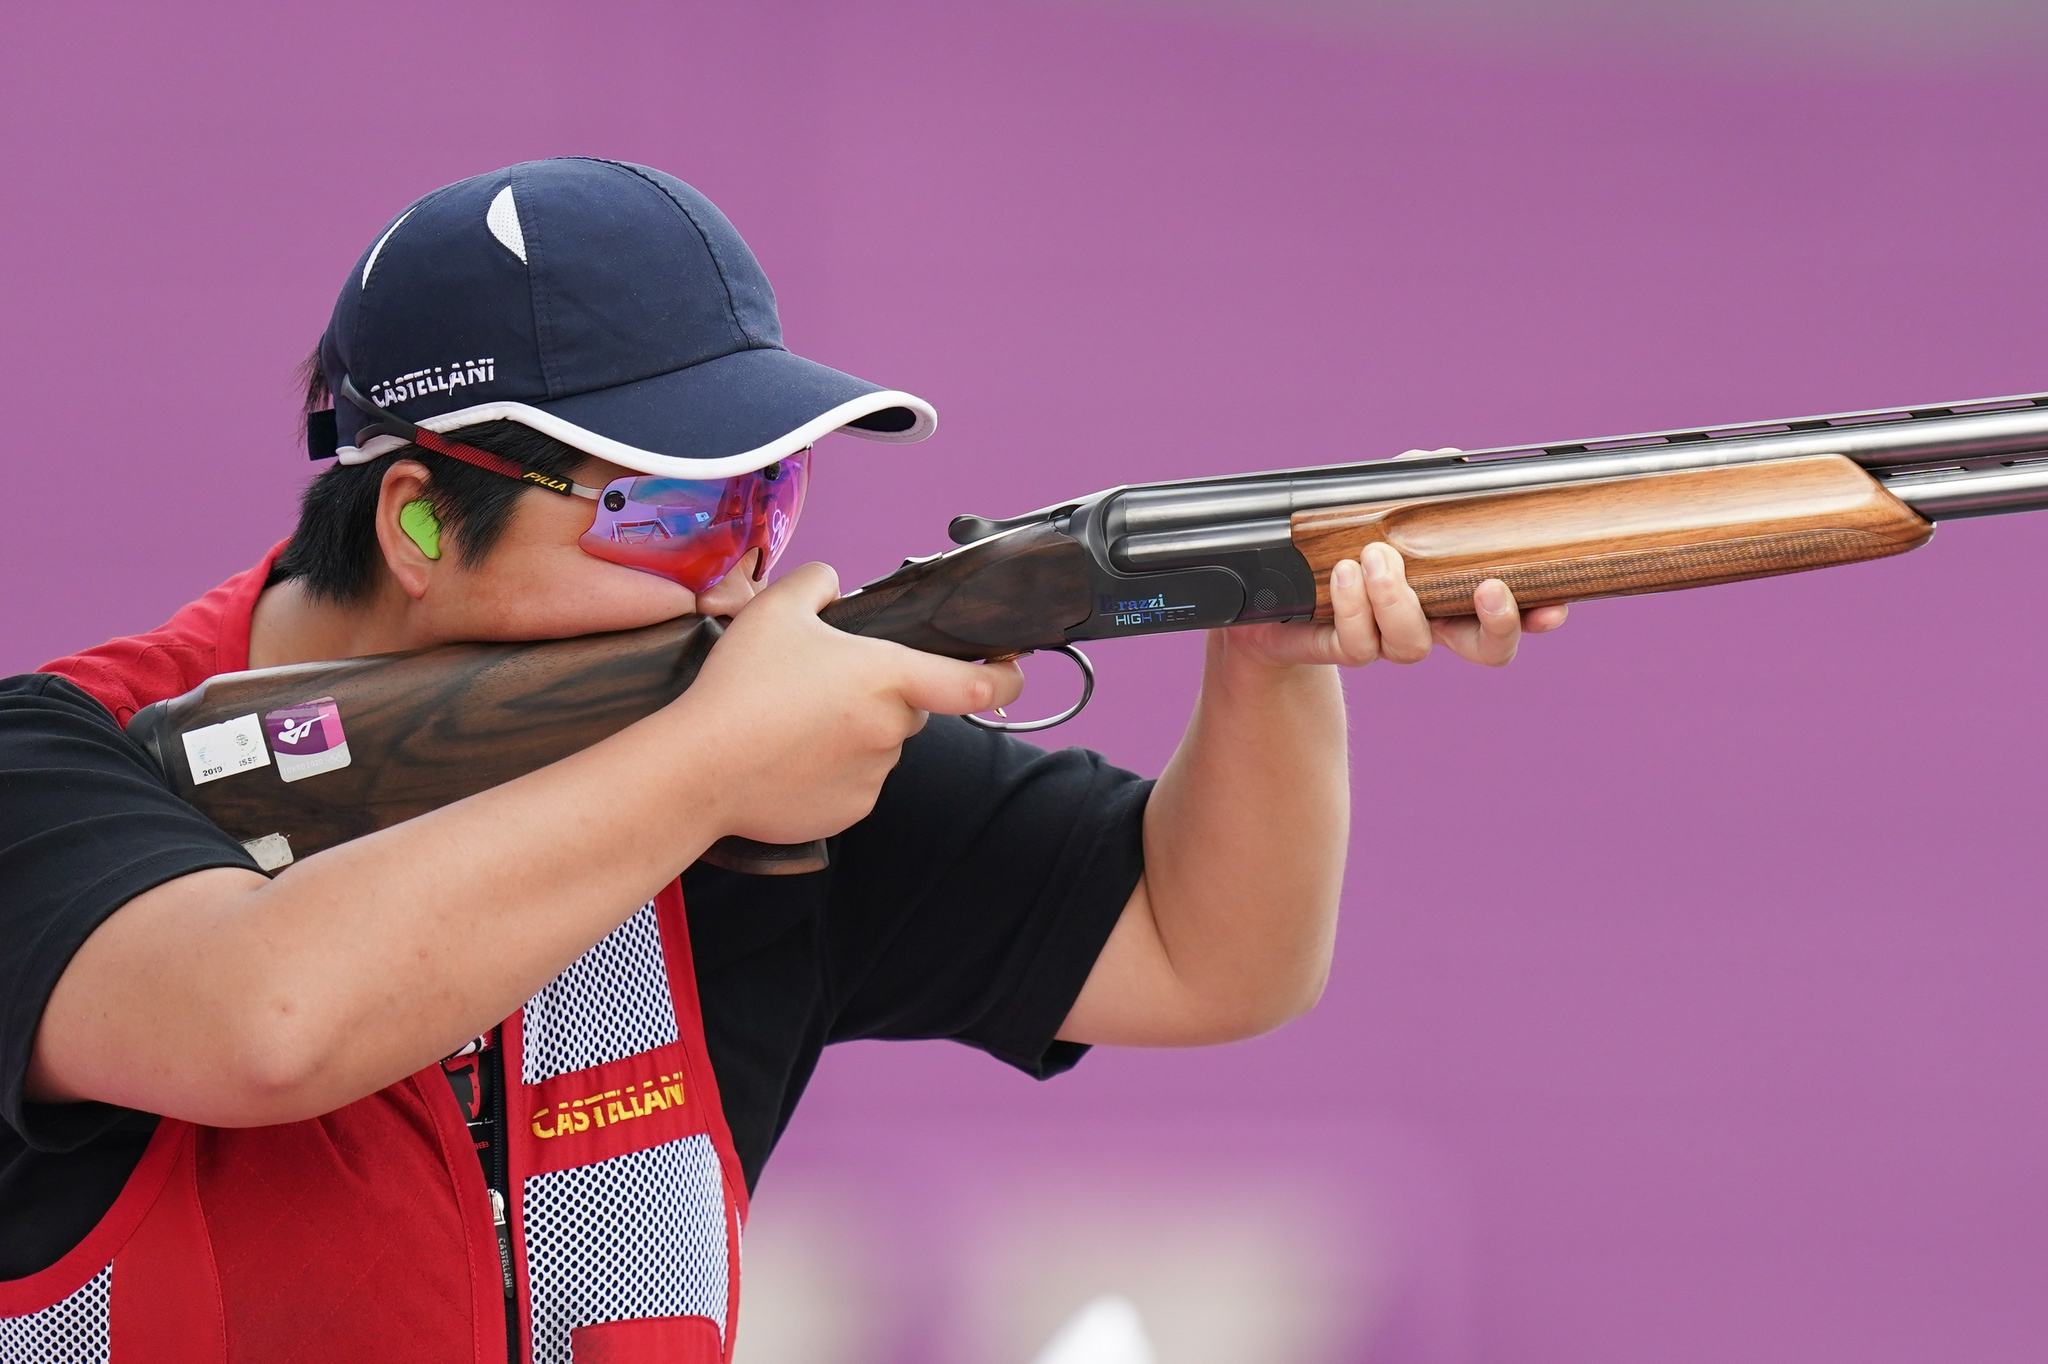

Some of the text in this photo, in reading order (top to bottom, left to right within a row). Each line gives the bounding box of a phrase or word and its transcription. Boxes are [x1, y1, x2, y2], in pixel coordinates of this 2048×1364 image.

[370, 358, 495, 408] CASTELLANI
[522, 471, 568, 492] PILLA
[1115, 613, 1153, 626] HIGH
[282, 758, 324, 774] TOKYO 2020
[498, 1237, 513, 1289] CASTELLANI
